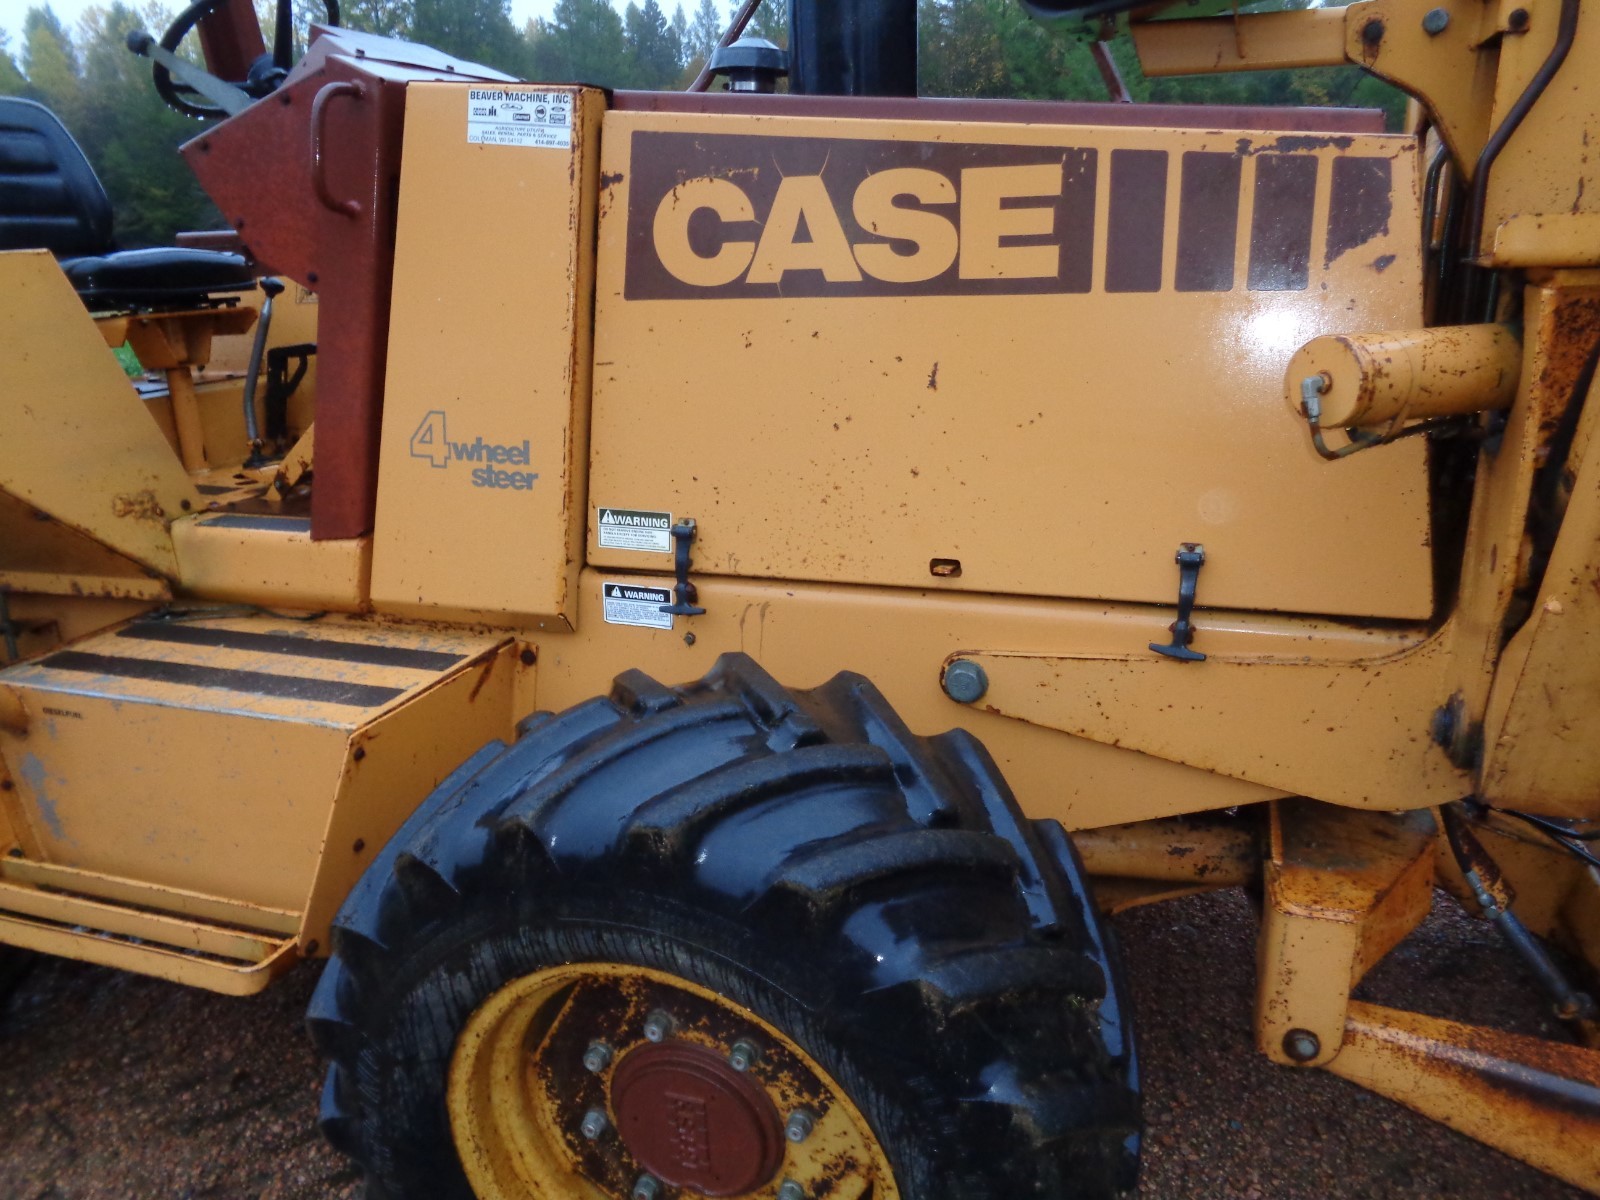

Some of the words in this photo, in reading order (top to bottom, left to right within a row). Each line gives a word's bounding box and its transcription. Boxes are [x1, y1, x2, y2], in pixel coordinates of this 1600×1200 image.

[470, 91, 503, 101] BEAVER
[505, 92, 550, 105] MACHINE,
[552, 94, 571, 104] INC.
[653, 163, 1063, 287] CASE
[410, 410, 451, 469] 4
[452, 436, 530, 465] wheel
[471, 463, 539, 491] steer
[613, 514, 669, 528] WARNING
[623, 590, 665, 602] WARNING
